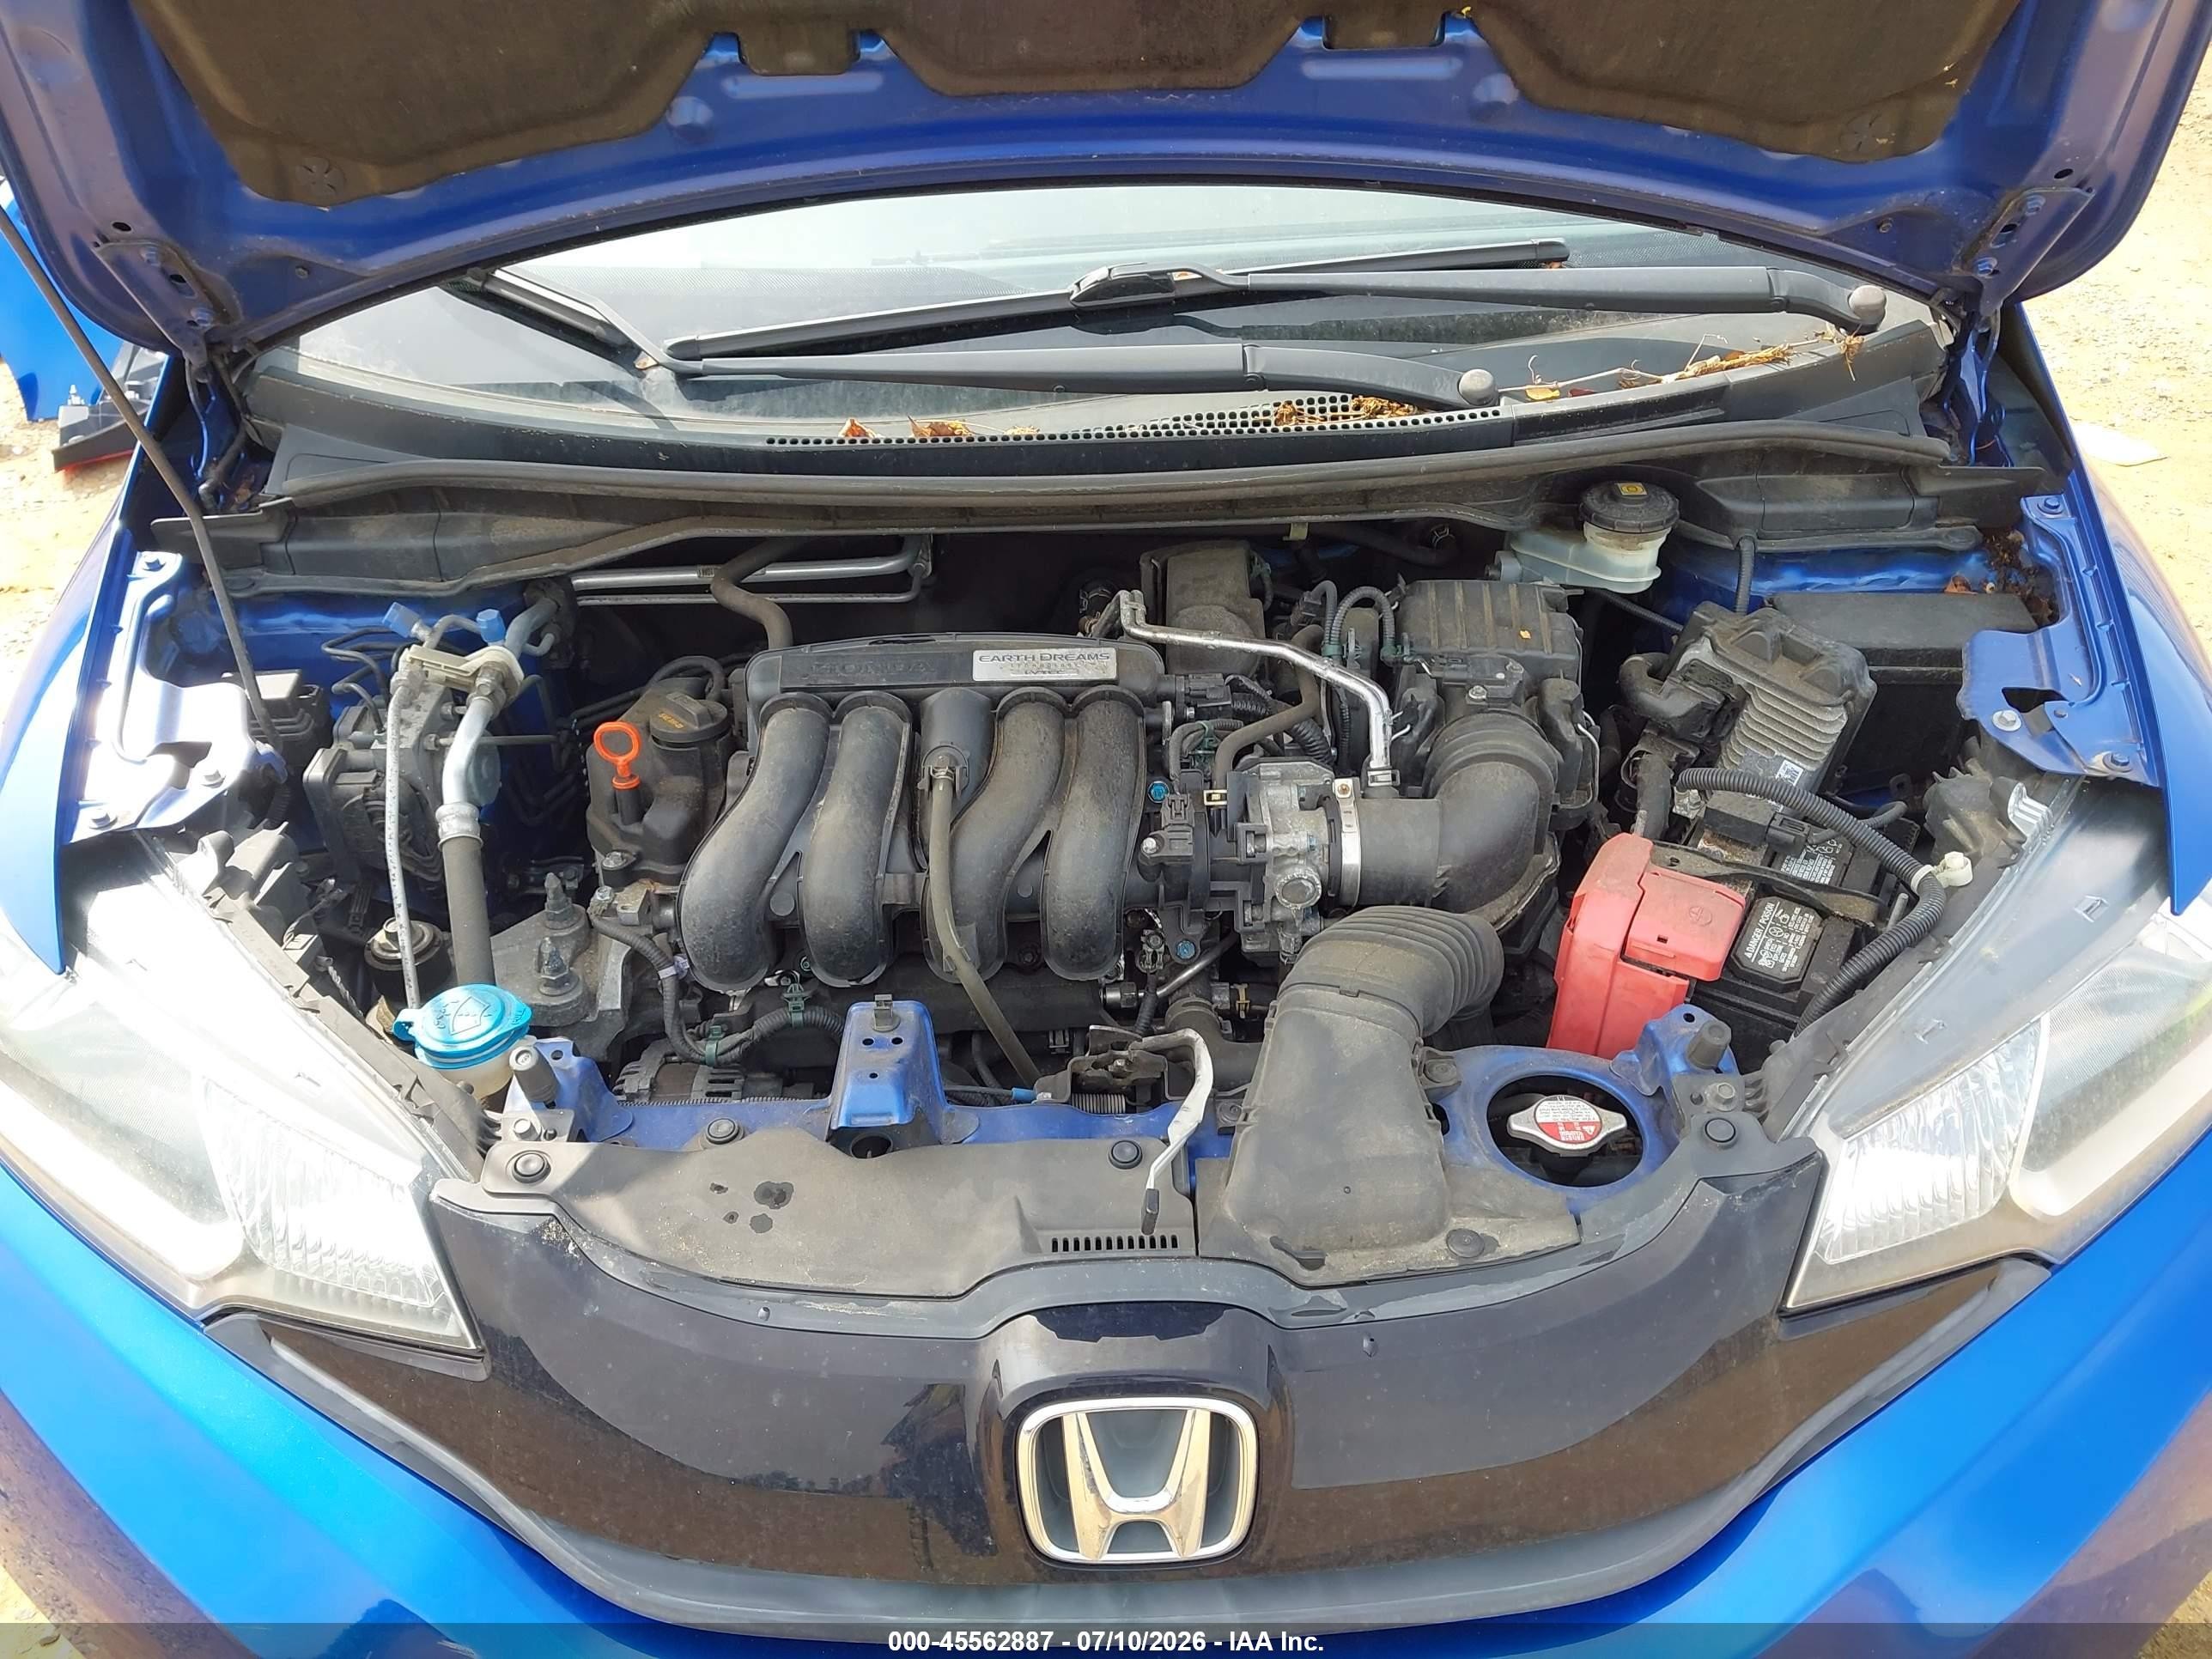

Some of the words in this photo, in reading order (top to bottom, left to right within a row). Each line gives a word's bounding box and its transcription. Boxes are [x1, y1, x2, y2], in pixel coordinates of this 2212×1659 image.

[979, 654, 1036, 663] EARTH
[1040, 653, 1110, 662] DREAMS
[1746, 927, 1764, 952] DANGER
[1759, 902, 1776, 925] POISON
